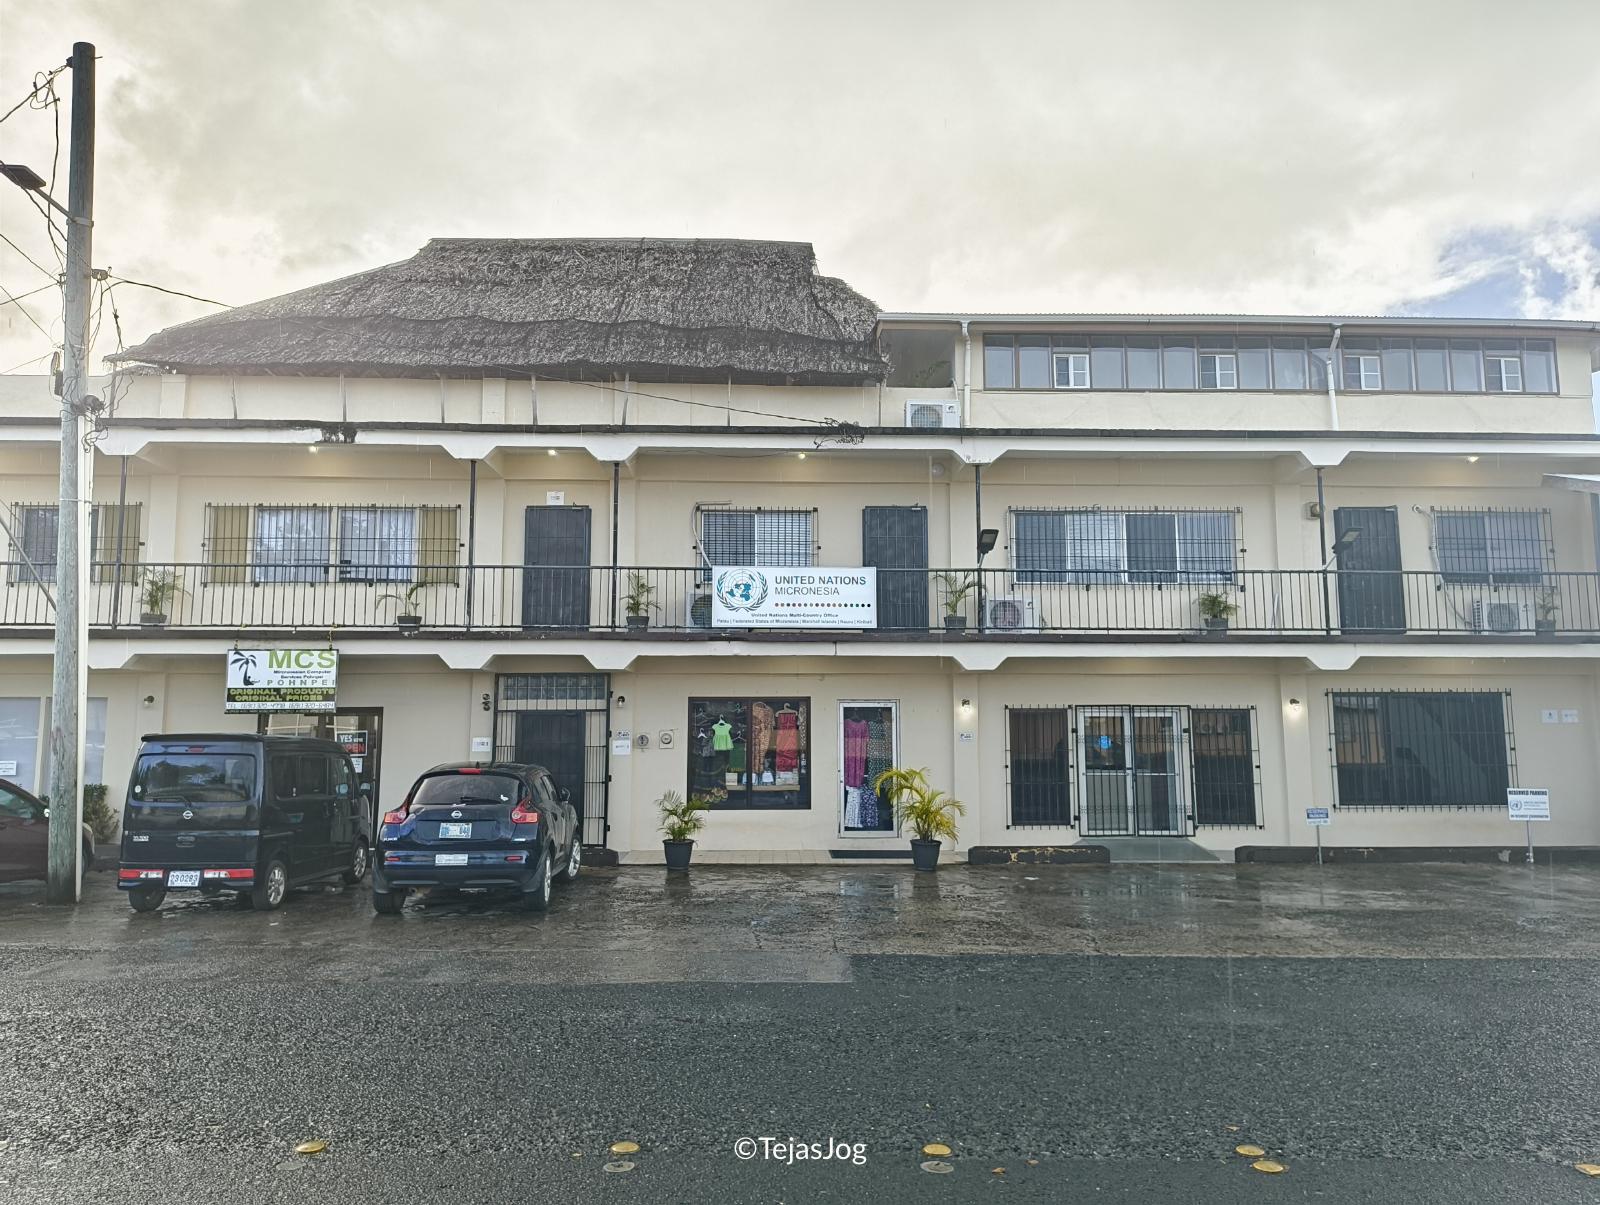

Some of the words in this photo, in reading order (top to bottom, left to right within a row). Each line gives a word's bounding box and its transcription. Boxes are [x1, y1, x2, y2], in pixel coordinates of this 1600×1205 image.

[775, 575, 815, 585] UNITED
[818, 575, 867, 586] NATIONS
[775, 586, 840, 596] MICRONESIA
[268, 650, 336, 668] MCS
[339, 734, 353, 743] YES
